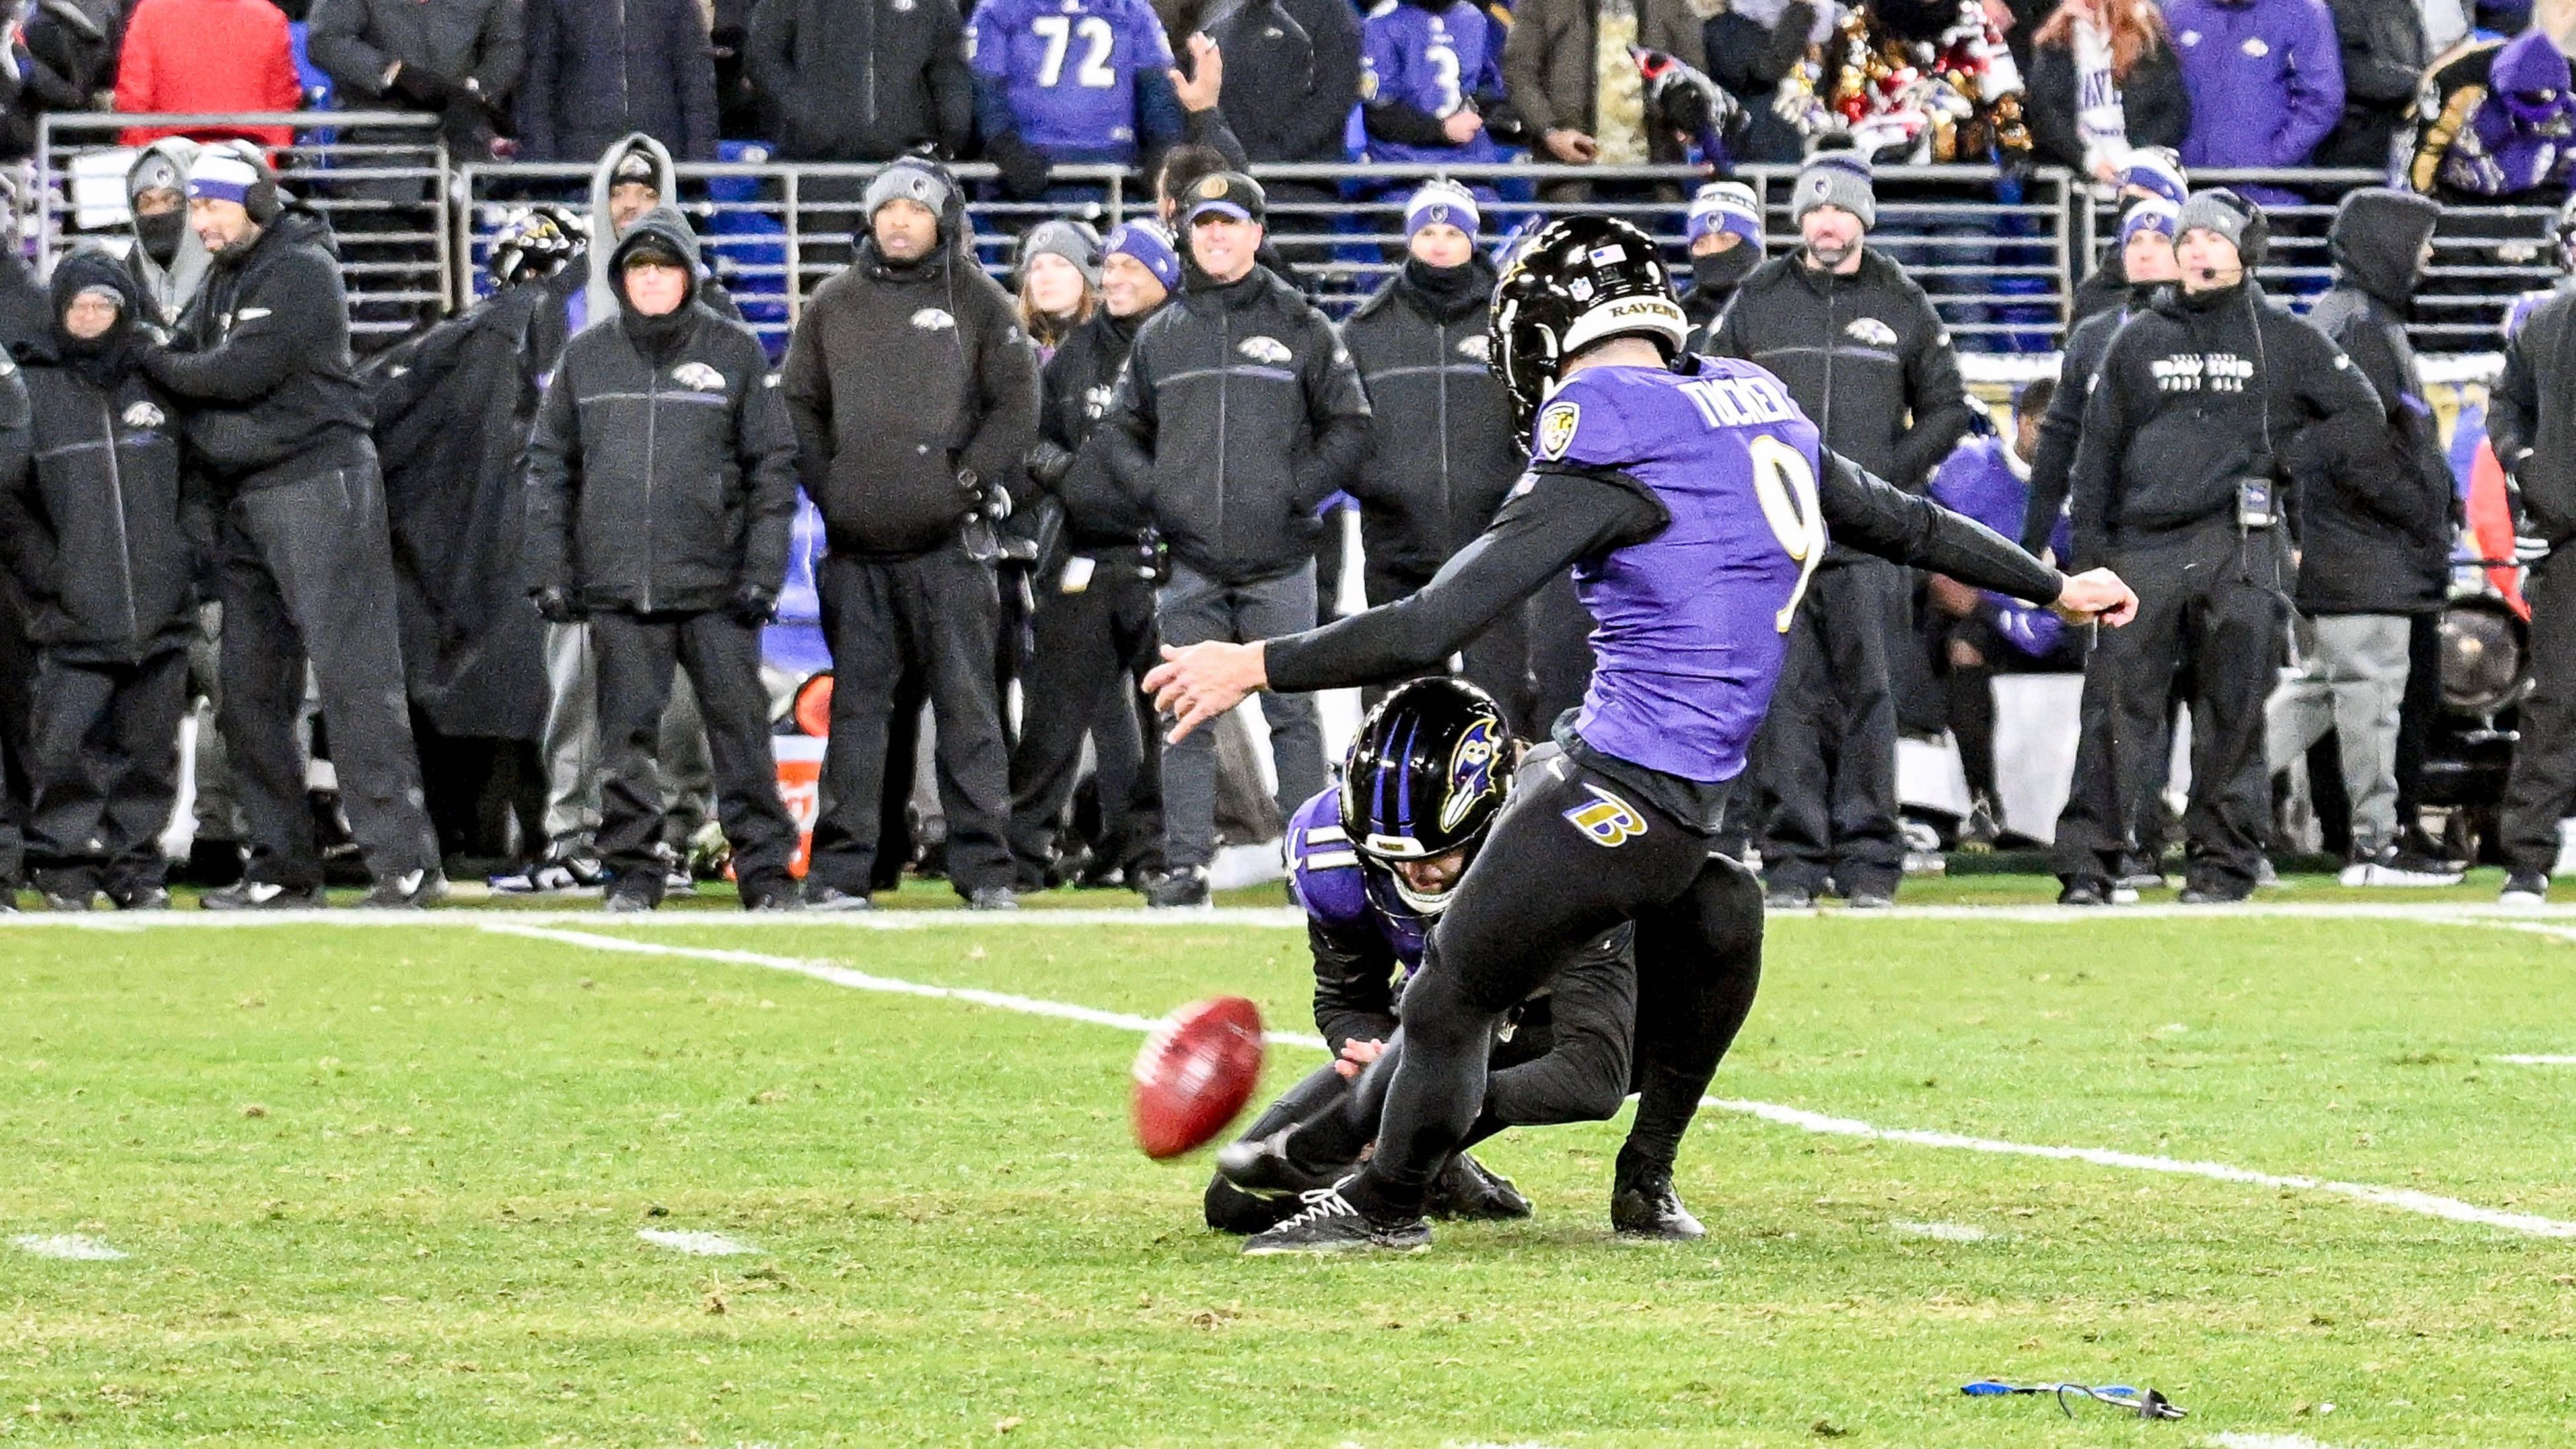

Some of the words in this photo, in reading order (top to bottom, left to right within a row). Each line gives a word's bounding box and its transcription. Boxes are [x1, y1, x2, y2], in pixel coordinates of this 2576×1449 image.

[1032, 15, 1116, 87] 72
[1425, 44, 1462, 120] 3
[1750, 435, 1825, 634] 9
